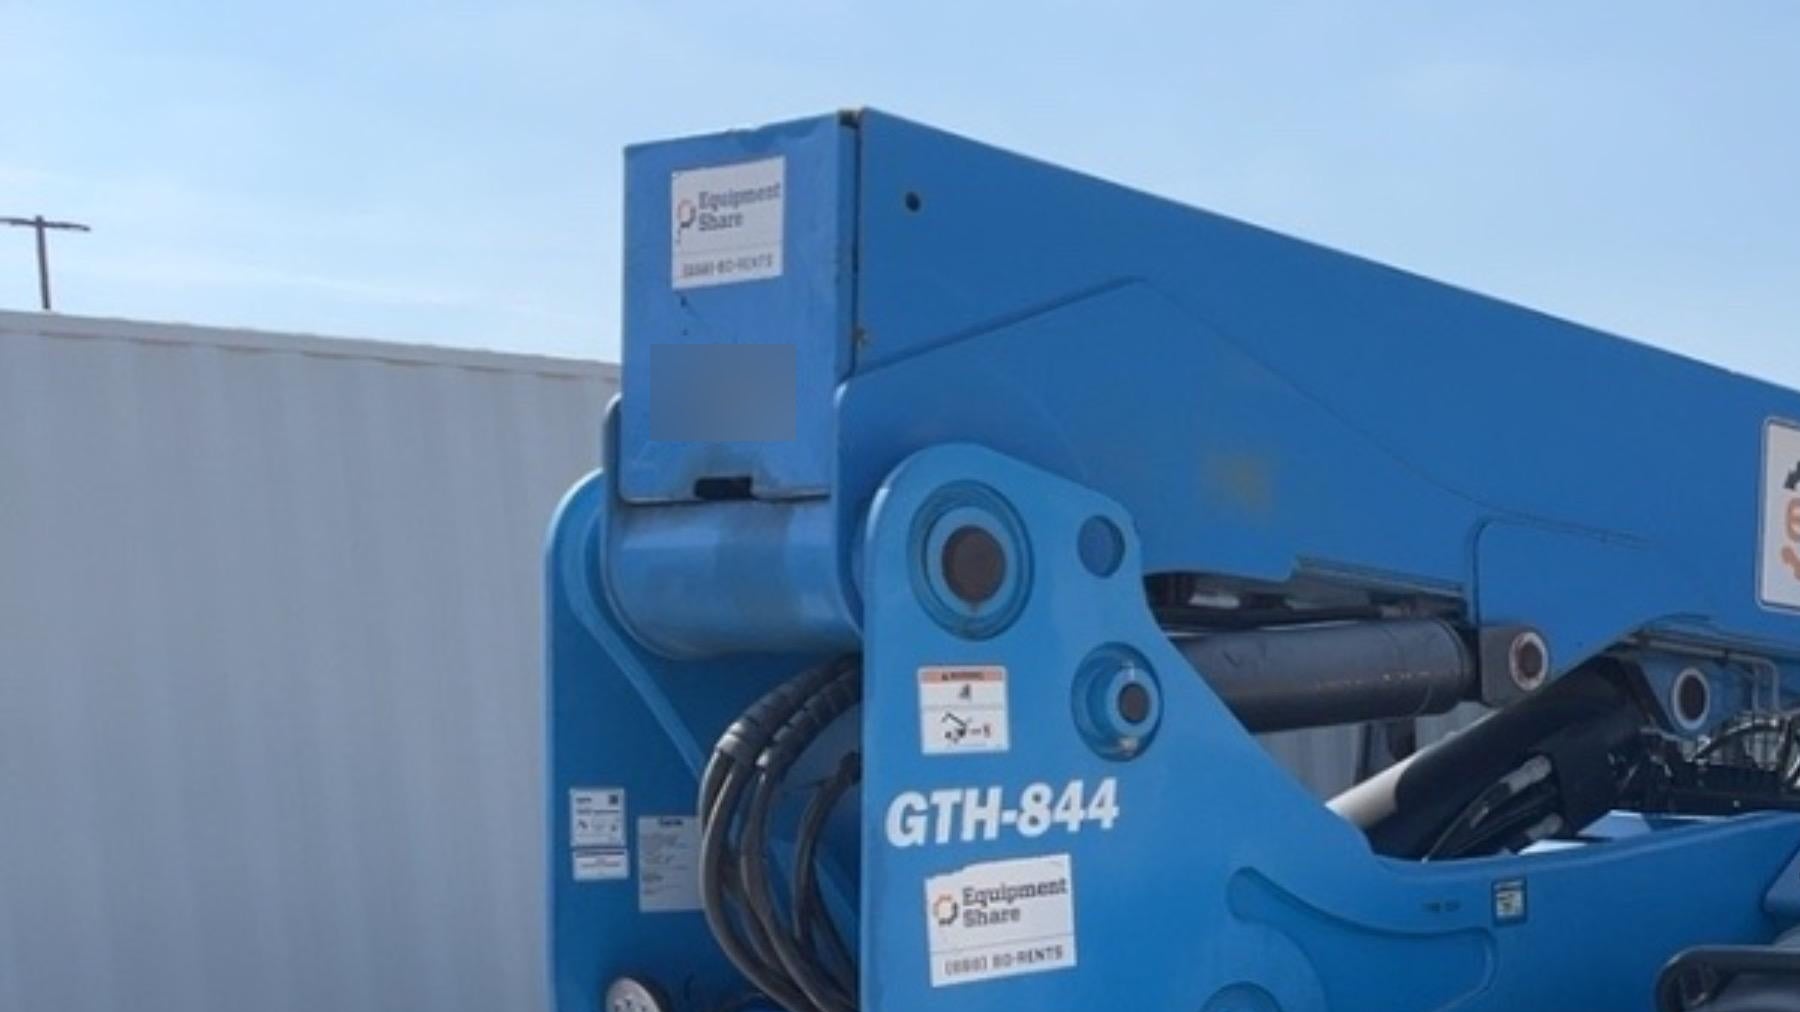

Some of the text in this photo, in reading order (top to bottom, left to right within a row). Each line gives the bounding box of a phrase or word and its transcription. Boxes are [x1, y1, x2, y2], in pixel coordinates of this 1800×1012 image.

[698, 212, 743, 232] Share
[886, 776, 1119, 847] GTH-844
[962, 877, 1068, 908] Equipment
[962, 907, 1021, 928] Share
